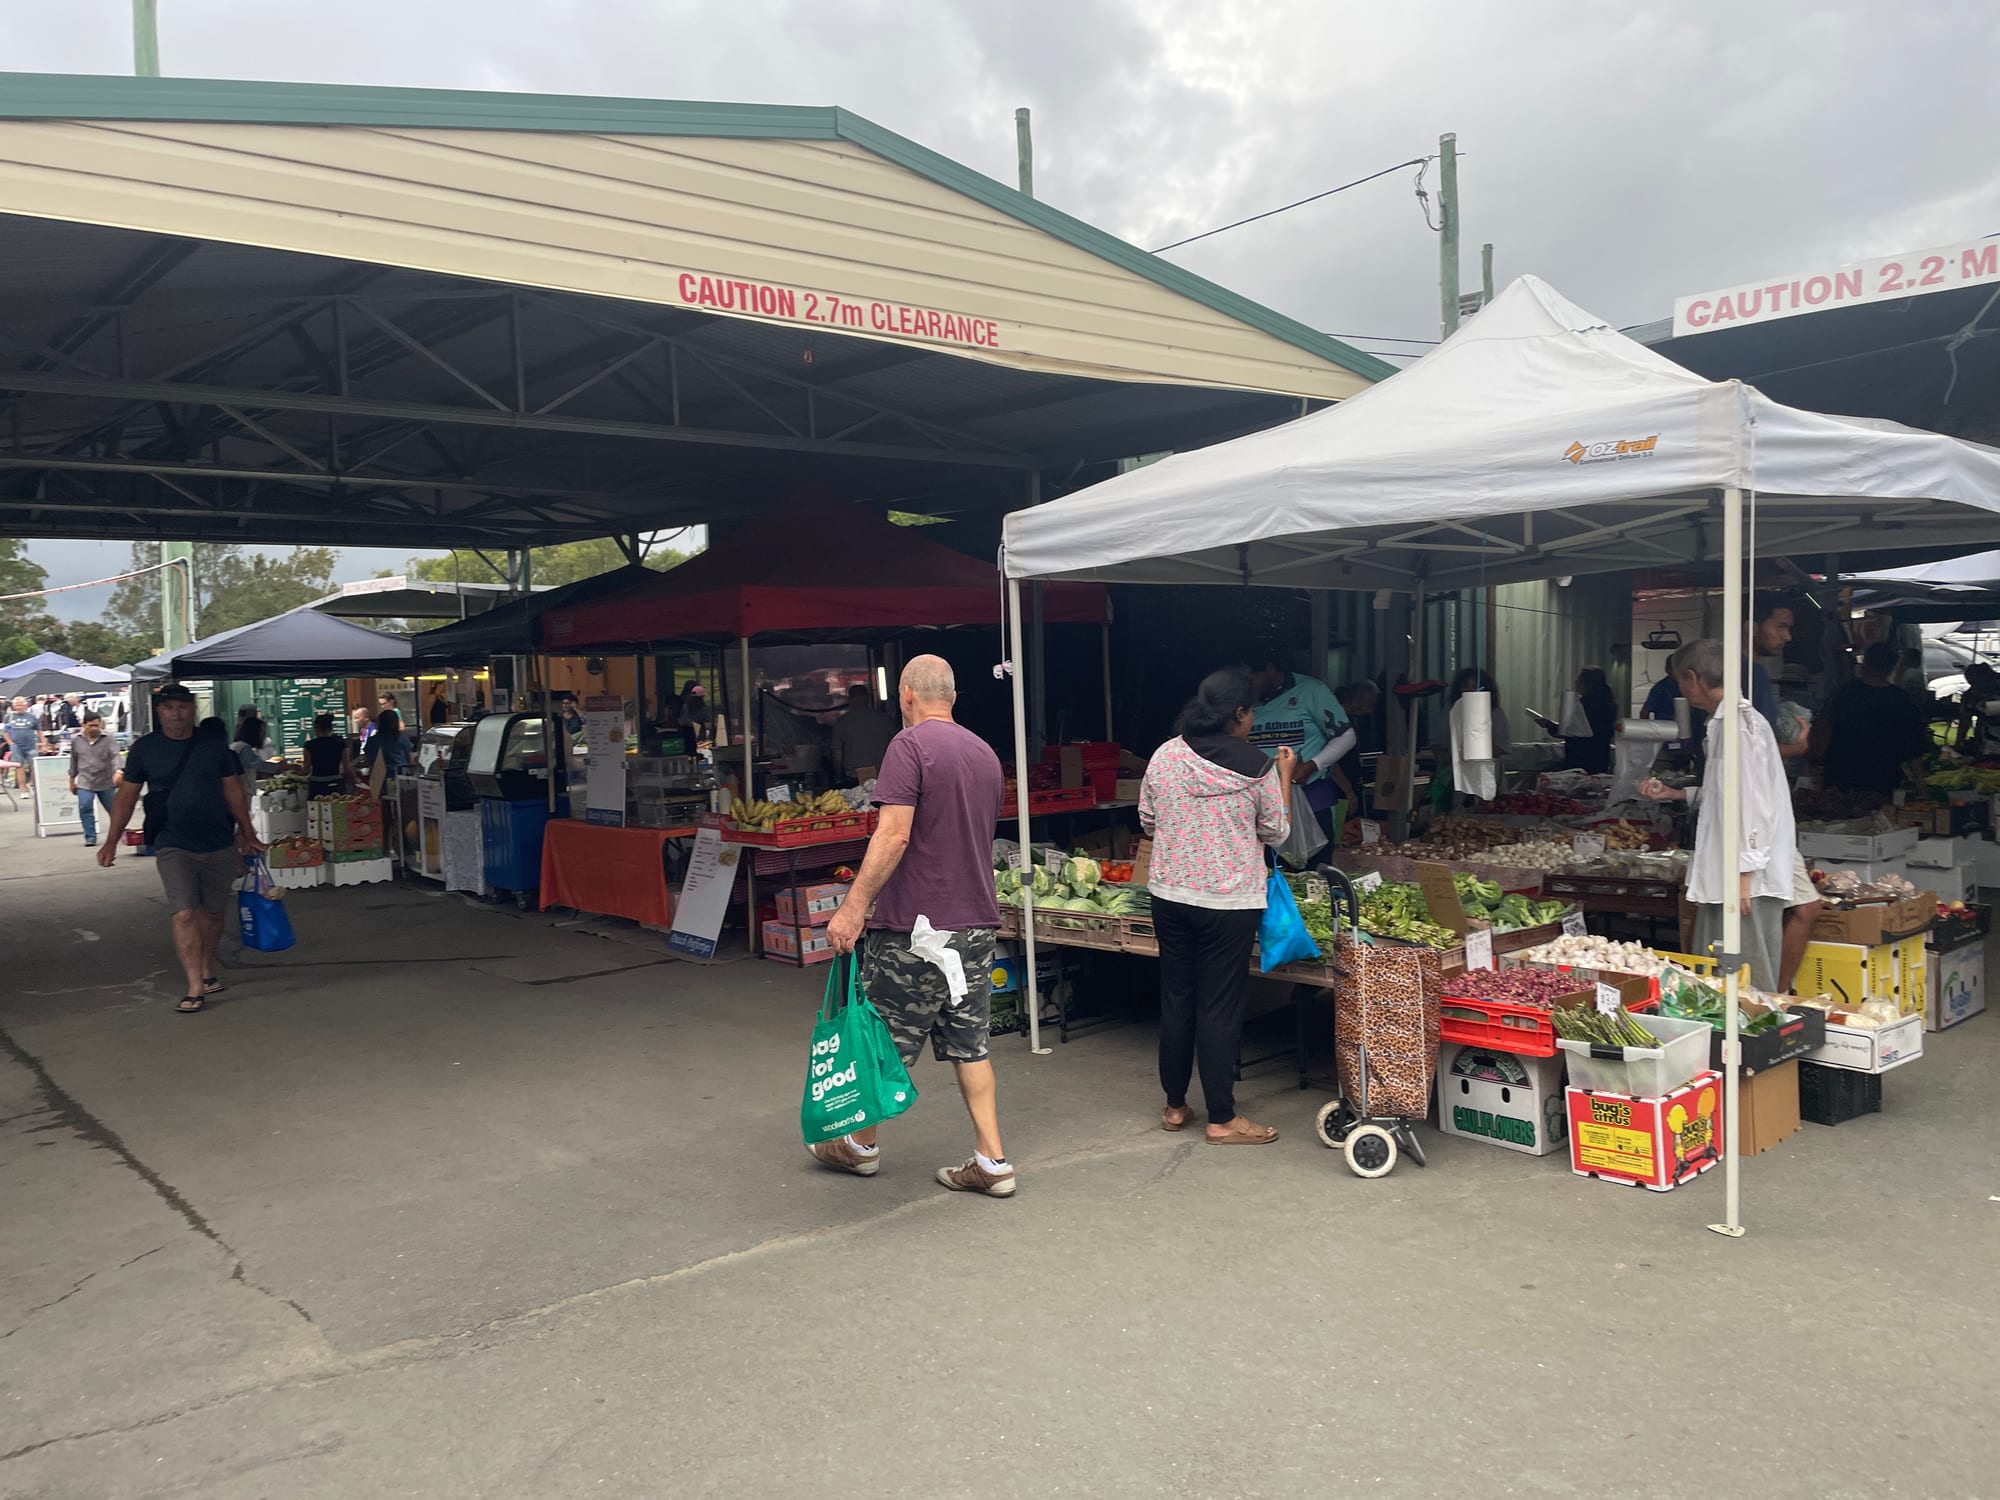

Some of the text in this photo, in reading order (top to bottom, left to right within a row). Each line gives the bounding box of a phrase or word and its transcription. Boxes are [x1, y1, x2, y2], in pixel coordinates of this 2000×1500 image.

[678, 273, 1000, 347] CAUTION 2.7m CLEARANCE
[1686, 269, 1863, 327] CAUTION
[1879, 256, 1945, 293] 2.2
[812, 1061, 857, 1102] good
[1453, 1104, 1536, 1148] CAULIFLOWERS
[1590, 1098, 1632, 1116] bug's
[1593, 1110, 1632, 1127] citrus
